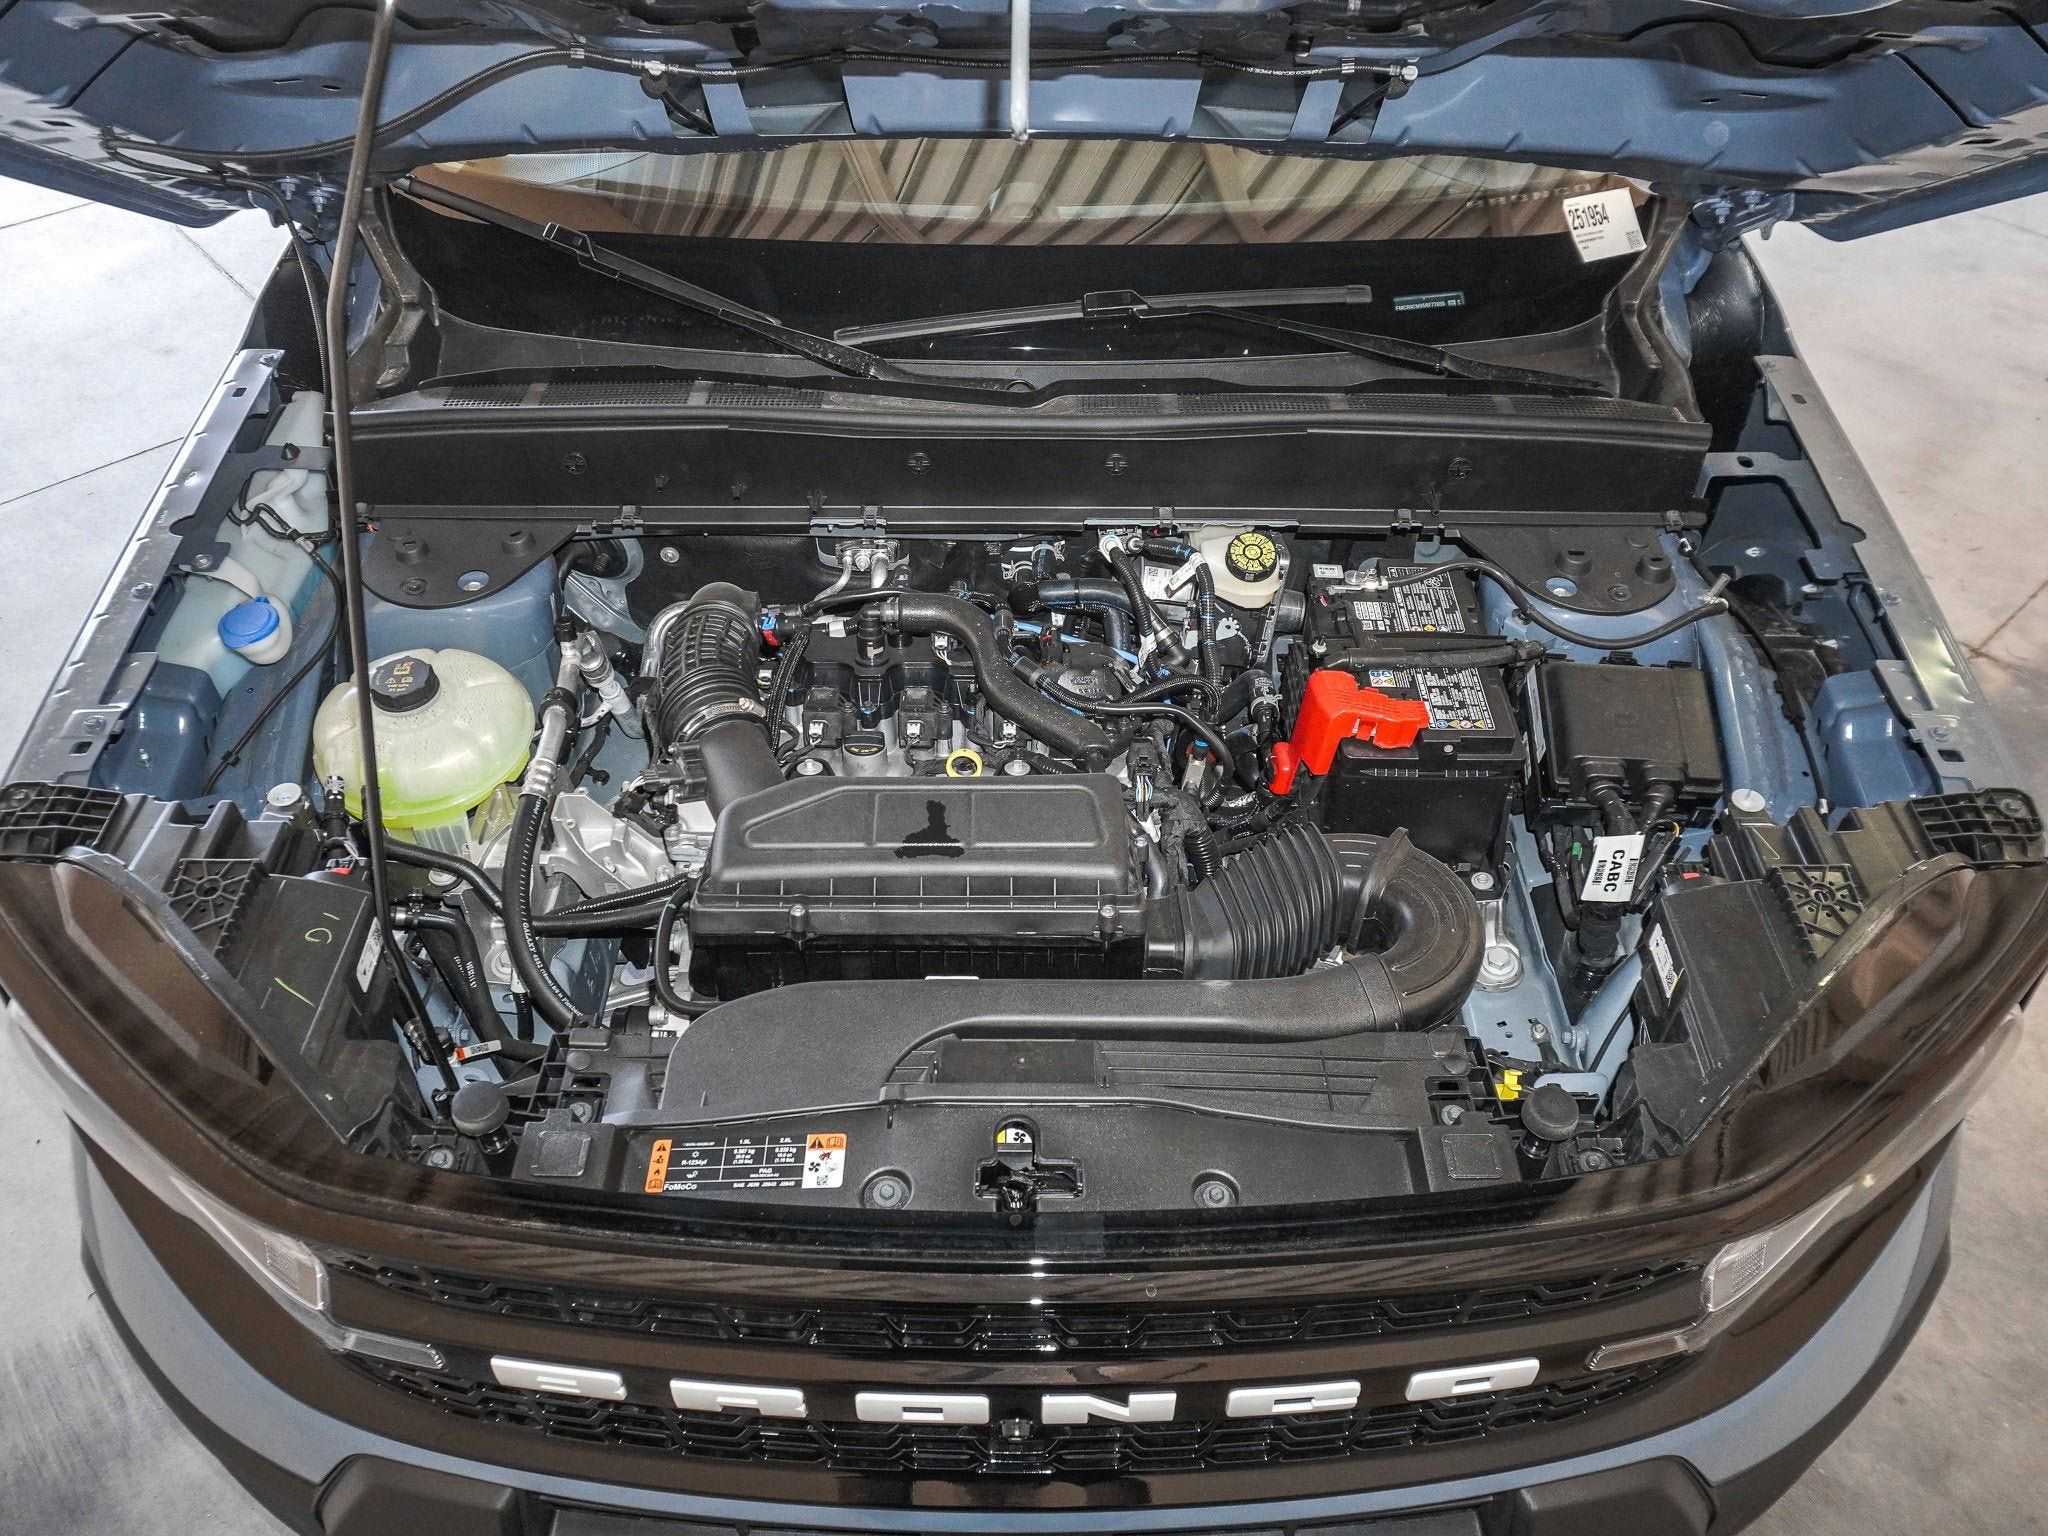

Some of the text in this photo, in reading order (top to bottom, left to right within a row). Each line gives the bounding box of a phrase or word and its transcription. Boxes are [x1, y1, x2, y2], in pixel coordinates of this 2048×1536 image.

[1568, 202, 1610, 231] 251954
[1604, 849, 1626, 893] CABC
[522, 922, 536, 953] GALAXY
[663, 1183, 697, 1191] FoMoCo
[490, 1355, 1540, 1424] BRONCO
